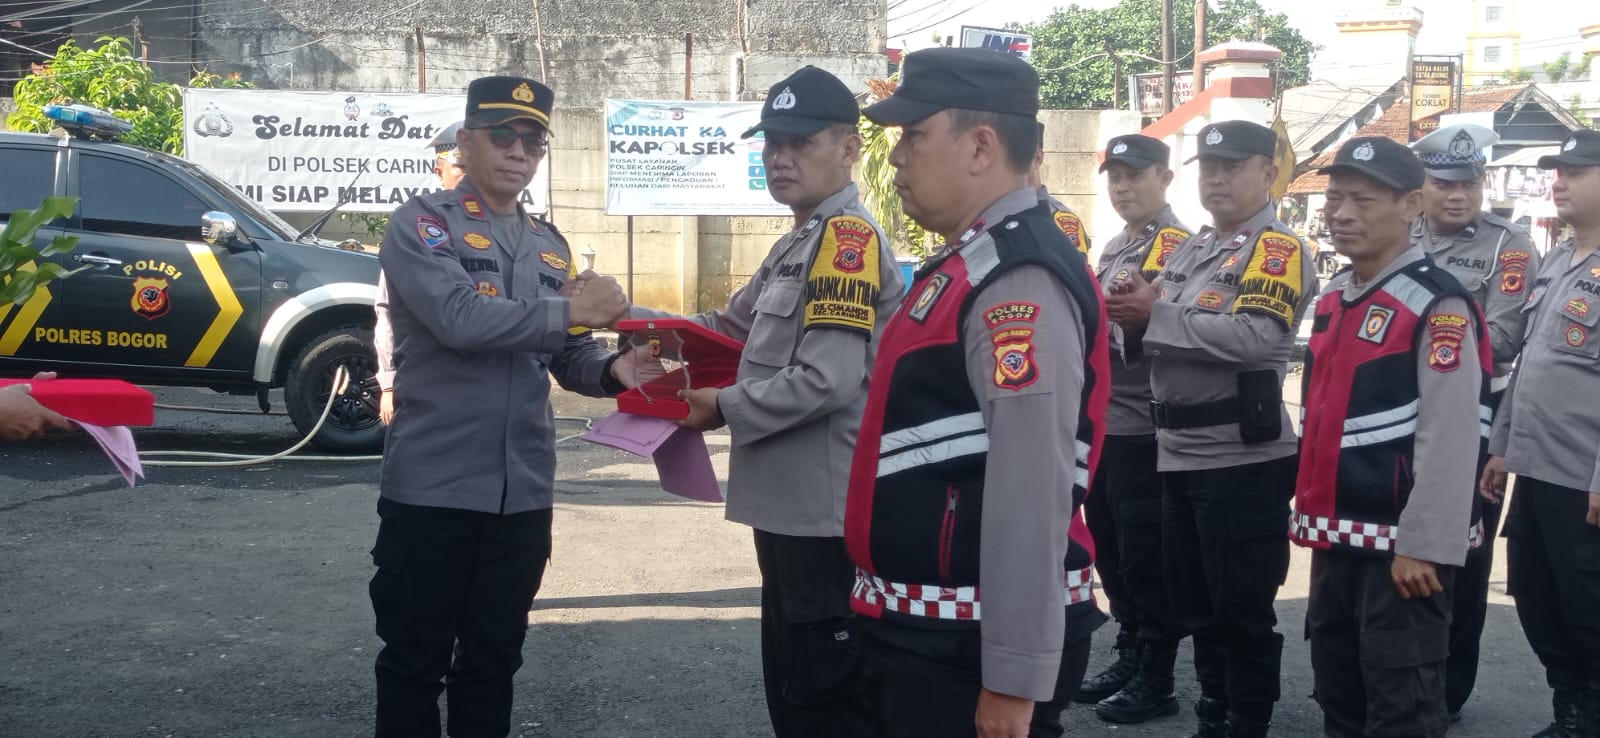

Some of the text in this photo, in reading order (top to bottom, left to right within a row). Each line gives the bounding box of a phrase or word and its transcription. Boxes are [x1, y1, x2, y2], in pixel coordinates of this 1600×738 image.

[1415, 99, 1448, 107] COKLAT
[252, 114, 441, 139] Selamat Dat
[611, 124, 727, 138] CURHAT KA
[610, 140, 735, 155] KAPOLSEK
[268, 156, 435, 174] DI POLSEK CARIN
[272, 185, 329, 203] SIAP
[338, 186, 445, 205] MELAYA
[122, 259, 183, 280] POLISI
[1446, 256, 1487, 270] POLRI
[1574, 279, 1600, 296] POLR
[988, 305, 1035, 320] POLRES
[35, 327, 168, 349] POLRES BOGOR
